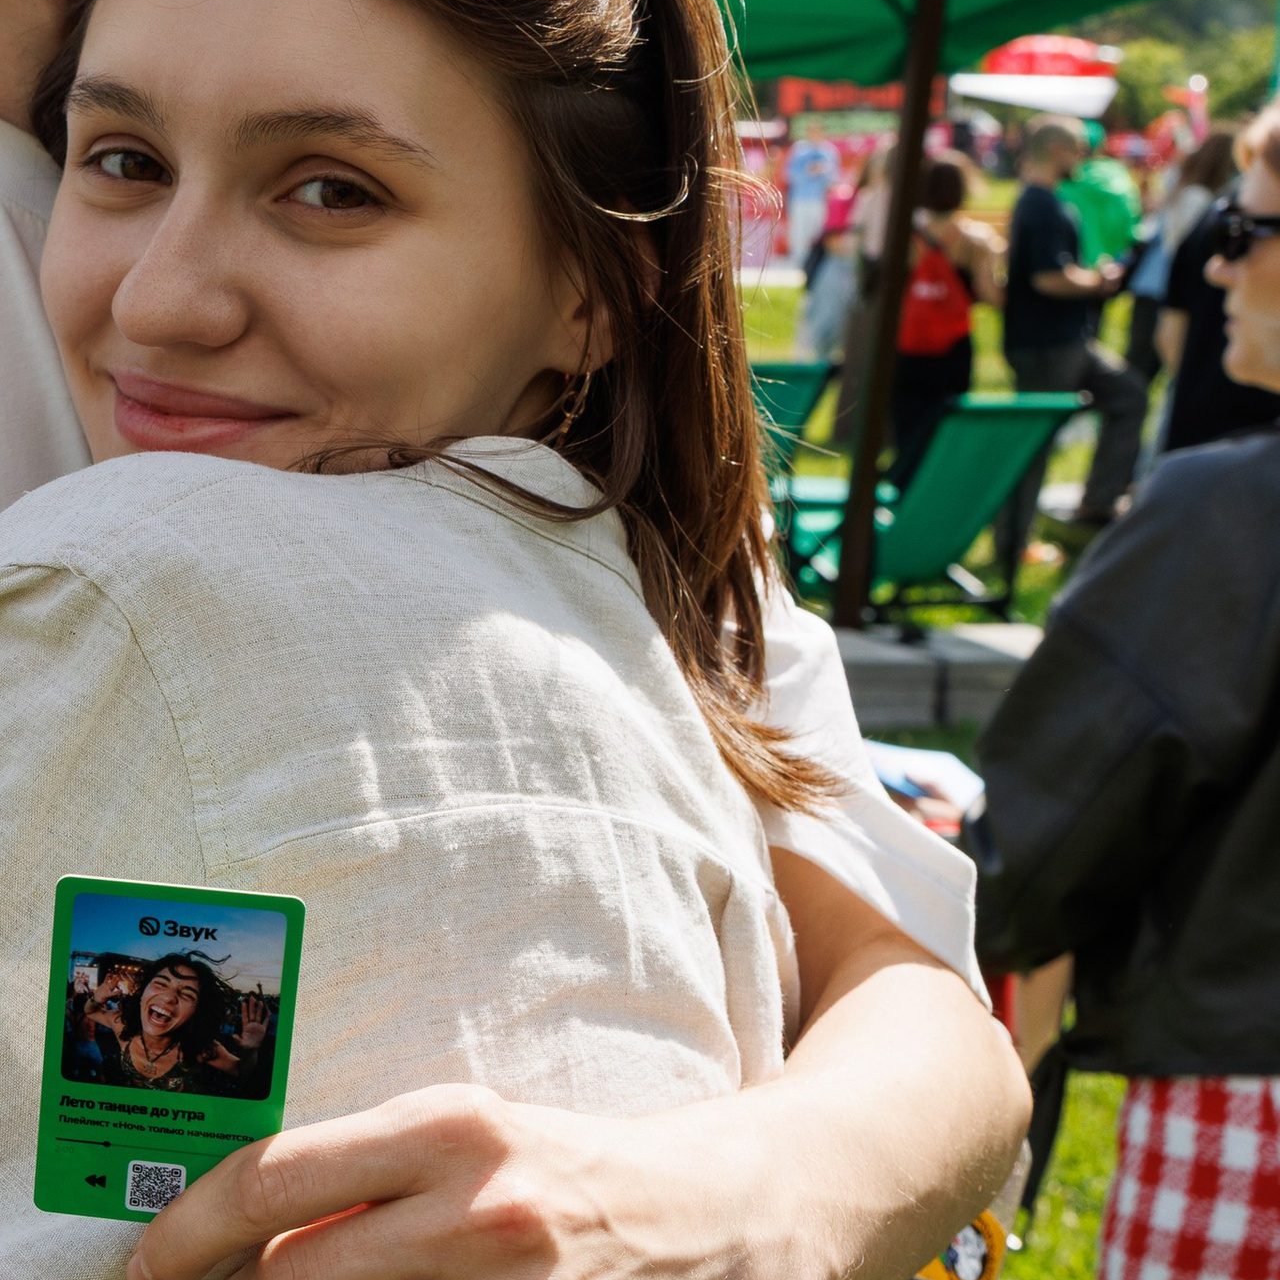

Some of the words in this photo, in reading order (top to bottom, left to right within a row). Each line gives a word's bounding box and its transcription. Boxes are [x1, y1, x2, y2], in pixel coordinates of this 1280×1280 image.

[163, 919, 218, 942] Звук
[59, 1094, 95, 1109] Лето
[97, 1101, 148, 1115] танцев
[149, 1106, 169, 1118] до
[171, 1109, 205, 1122] утра
[59, 1114, 110, 1128] Плейлист
[112, 1120, 146, 1132] «Ночь
[147, 1125, 184, 1136] только
[187, 1129, 255, 1142] начинается»
